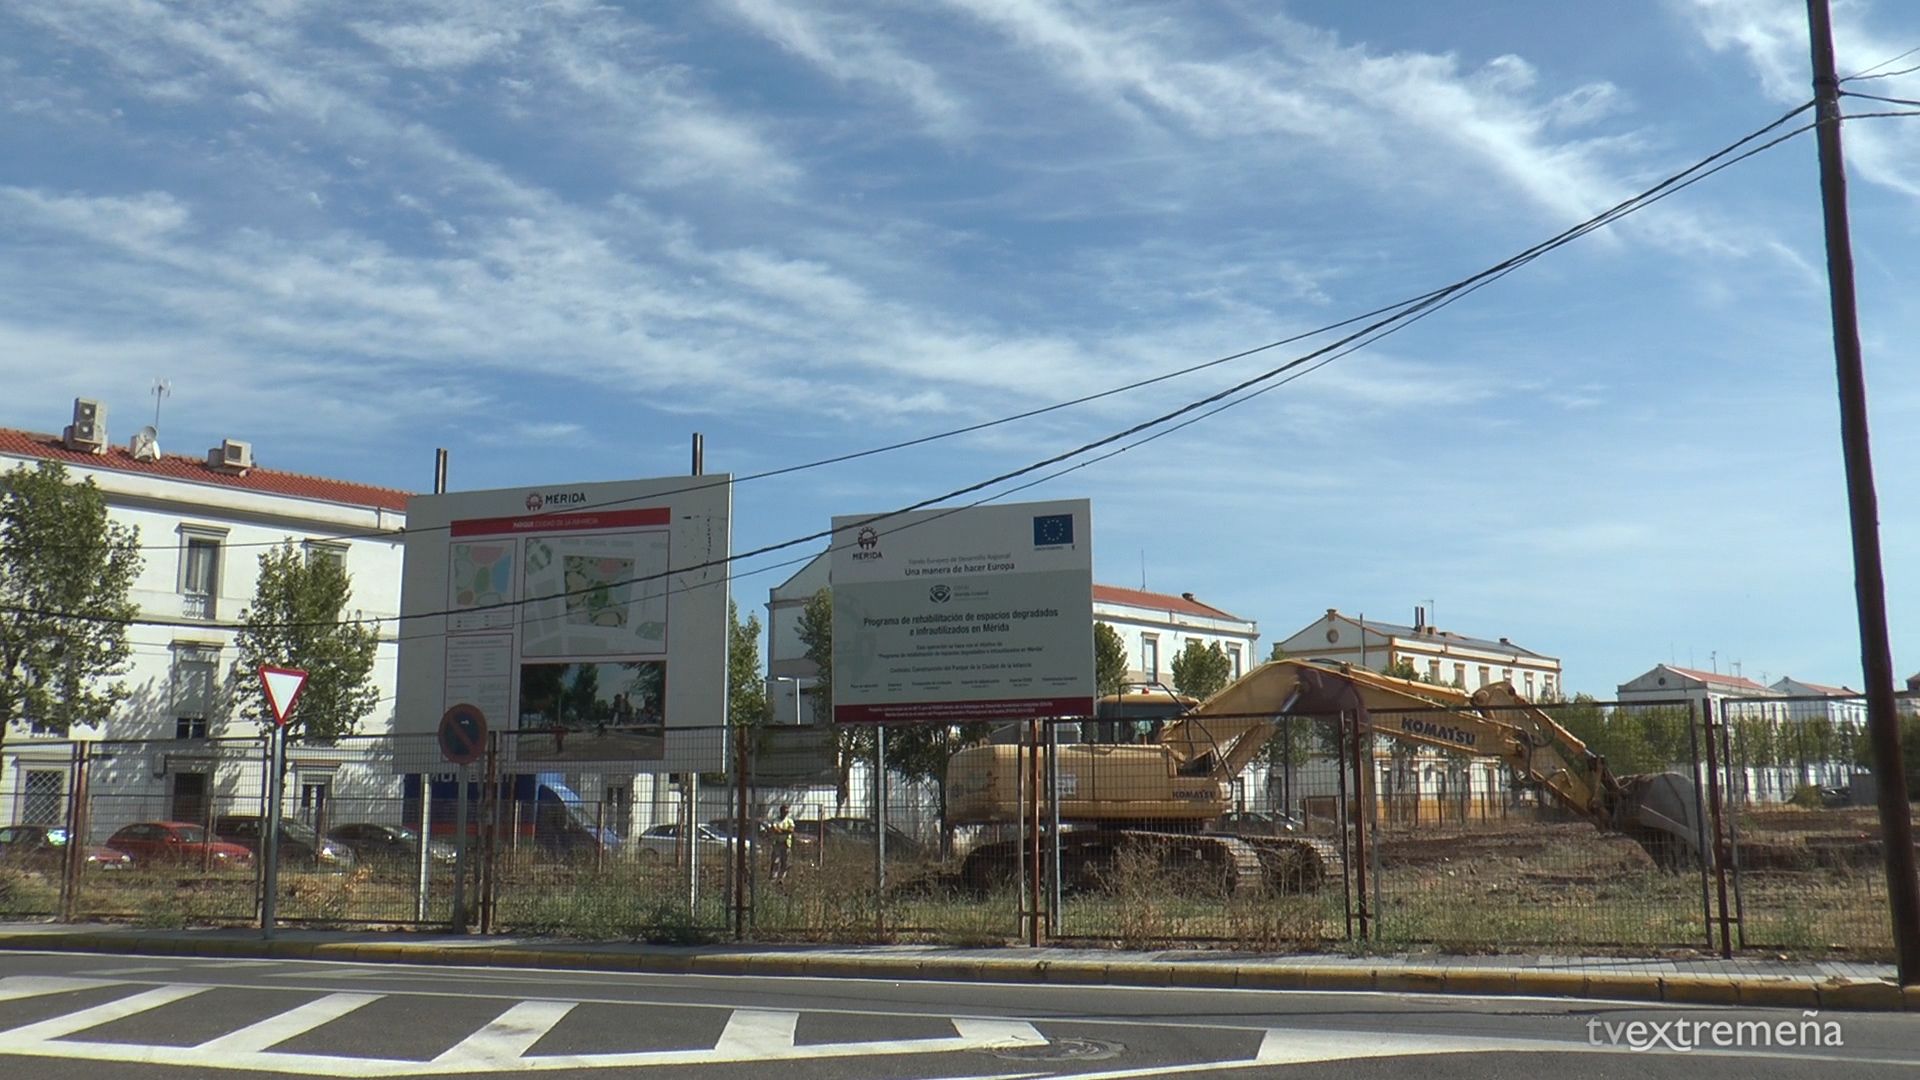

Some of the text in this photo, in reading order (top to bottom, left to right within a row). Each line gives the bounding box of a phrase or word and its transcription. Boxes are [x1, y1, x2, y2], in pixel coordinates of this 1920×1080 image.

[904, 562, 1015, 576] Una manera de hacer Europa
[864, 616, 899, 627] Programa
[901, 615, 910, 625] de
[965, 612, 975, 622] de
[976, 610, 1010, 621] espacios
[1012, 608, 1058, 620] degradados
[972, 625, 981, 634] en
[1401, 716, 1476, 746] KOMATSU
[1172, 789, 1217, 800] KOMATSU
